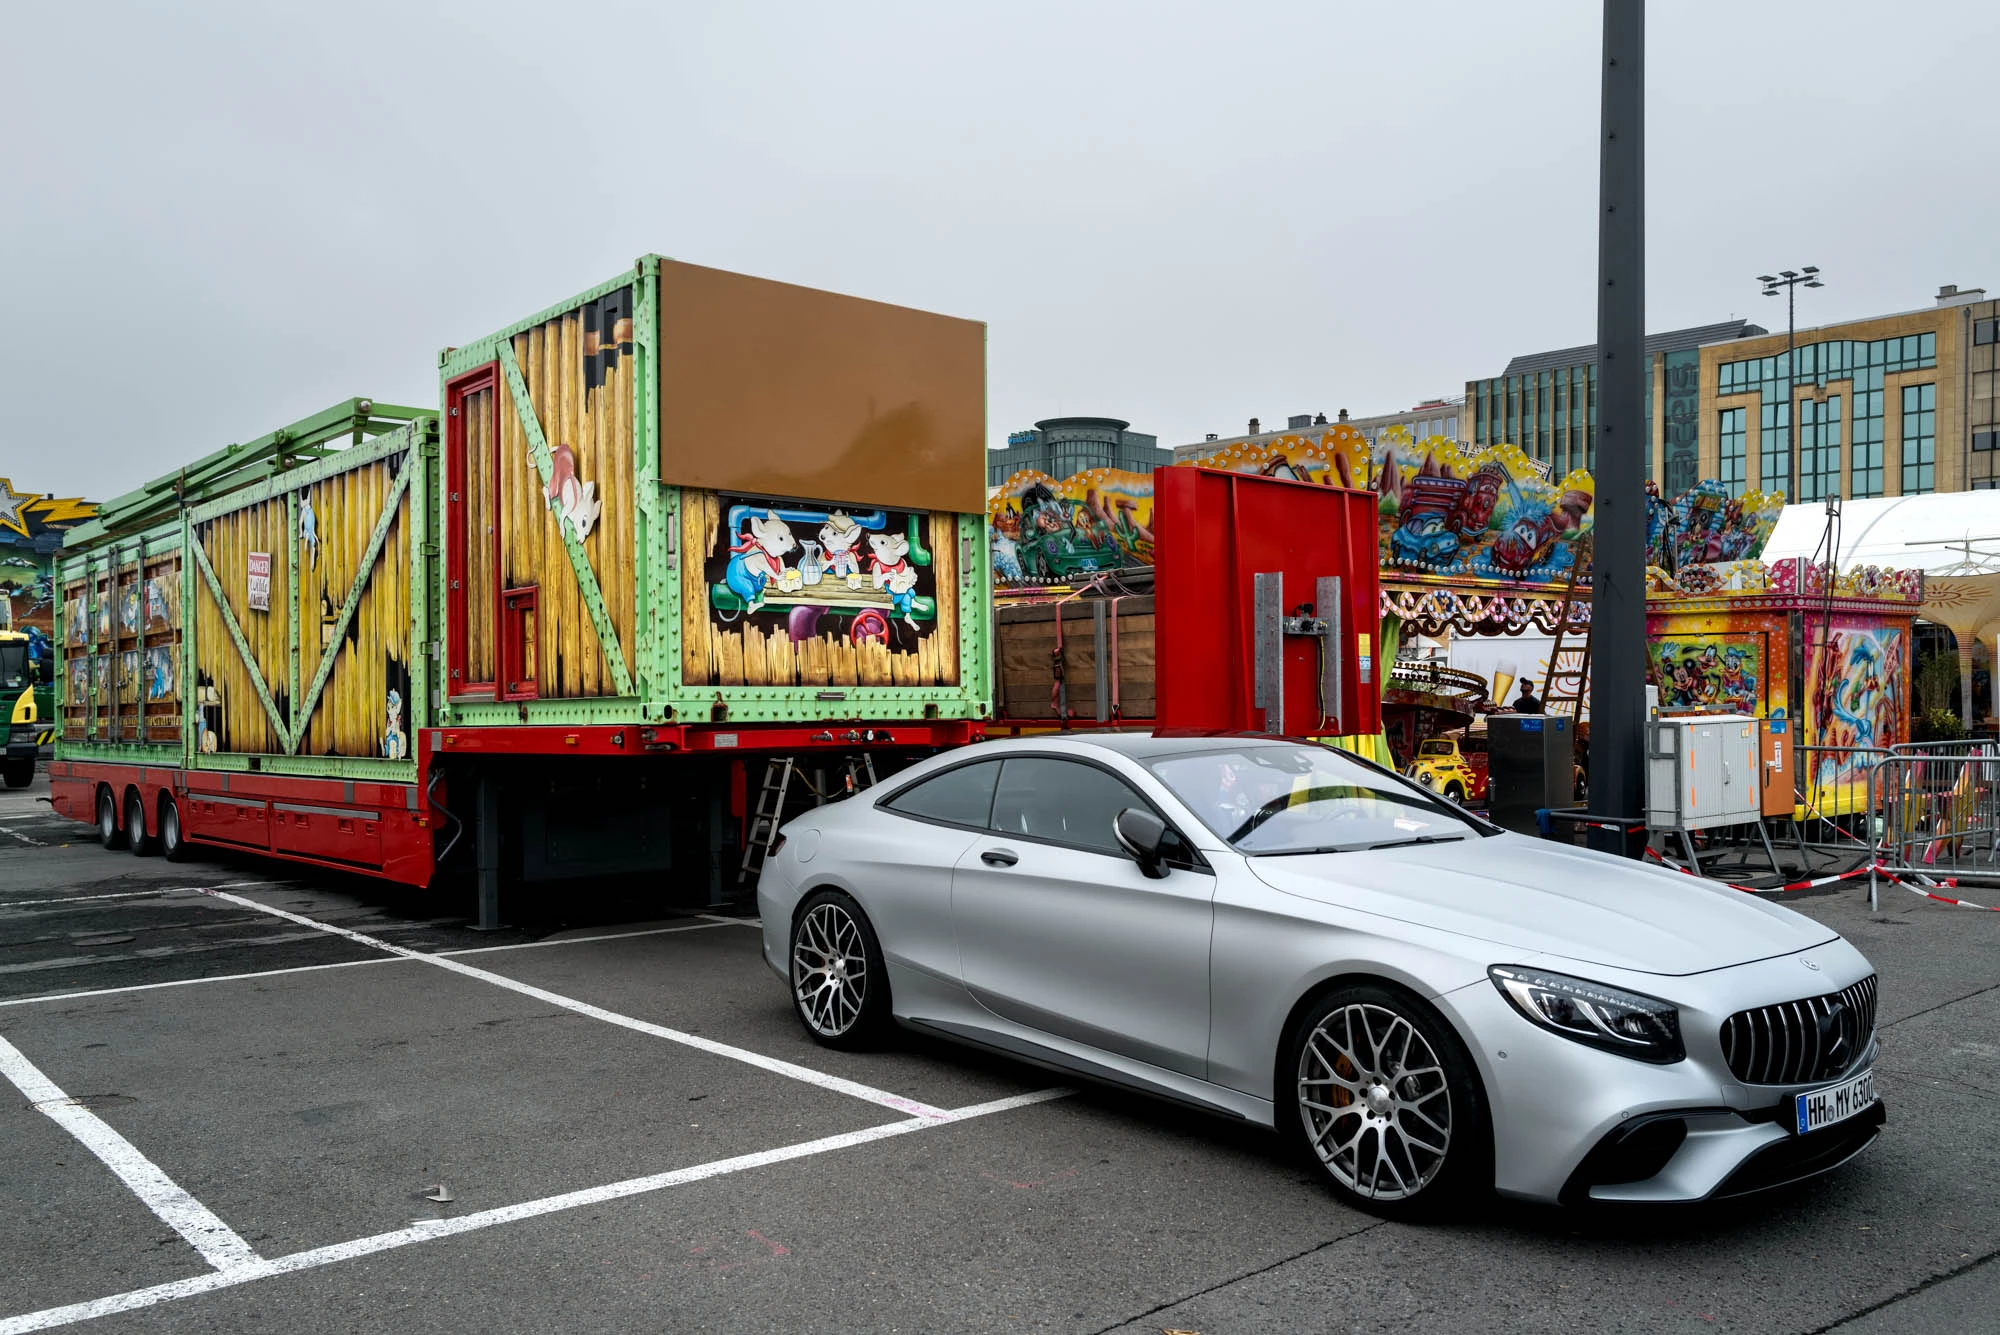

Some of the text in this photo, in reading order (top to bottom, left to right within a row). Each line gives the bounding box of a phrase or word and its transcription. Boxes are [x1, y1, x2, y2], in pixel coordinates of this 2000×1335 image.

[249, 559, 269, 574] DANGER
[1808, 1074, 1873, 1126] HH MY 6300
